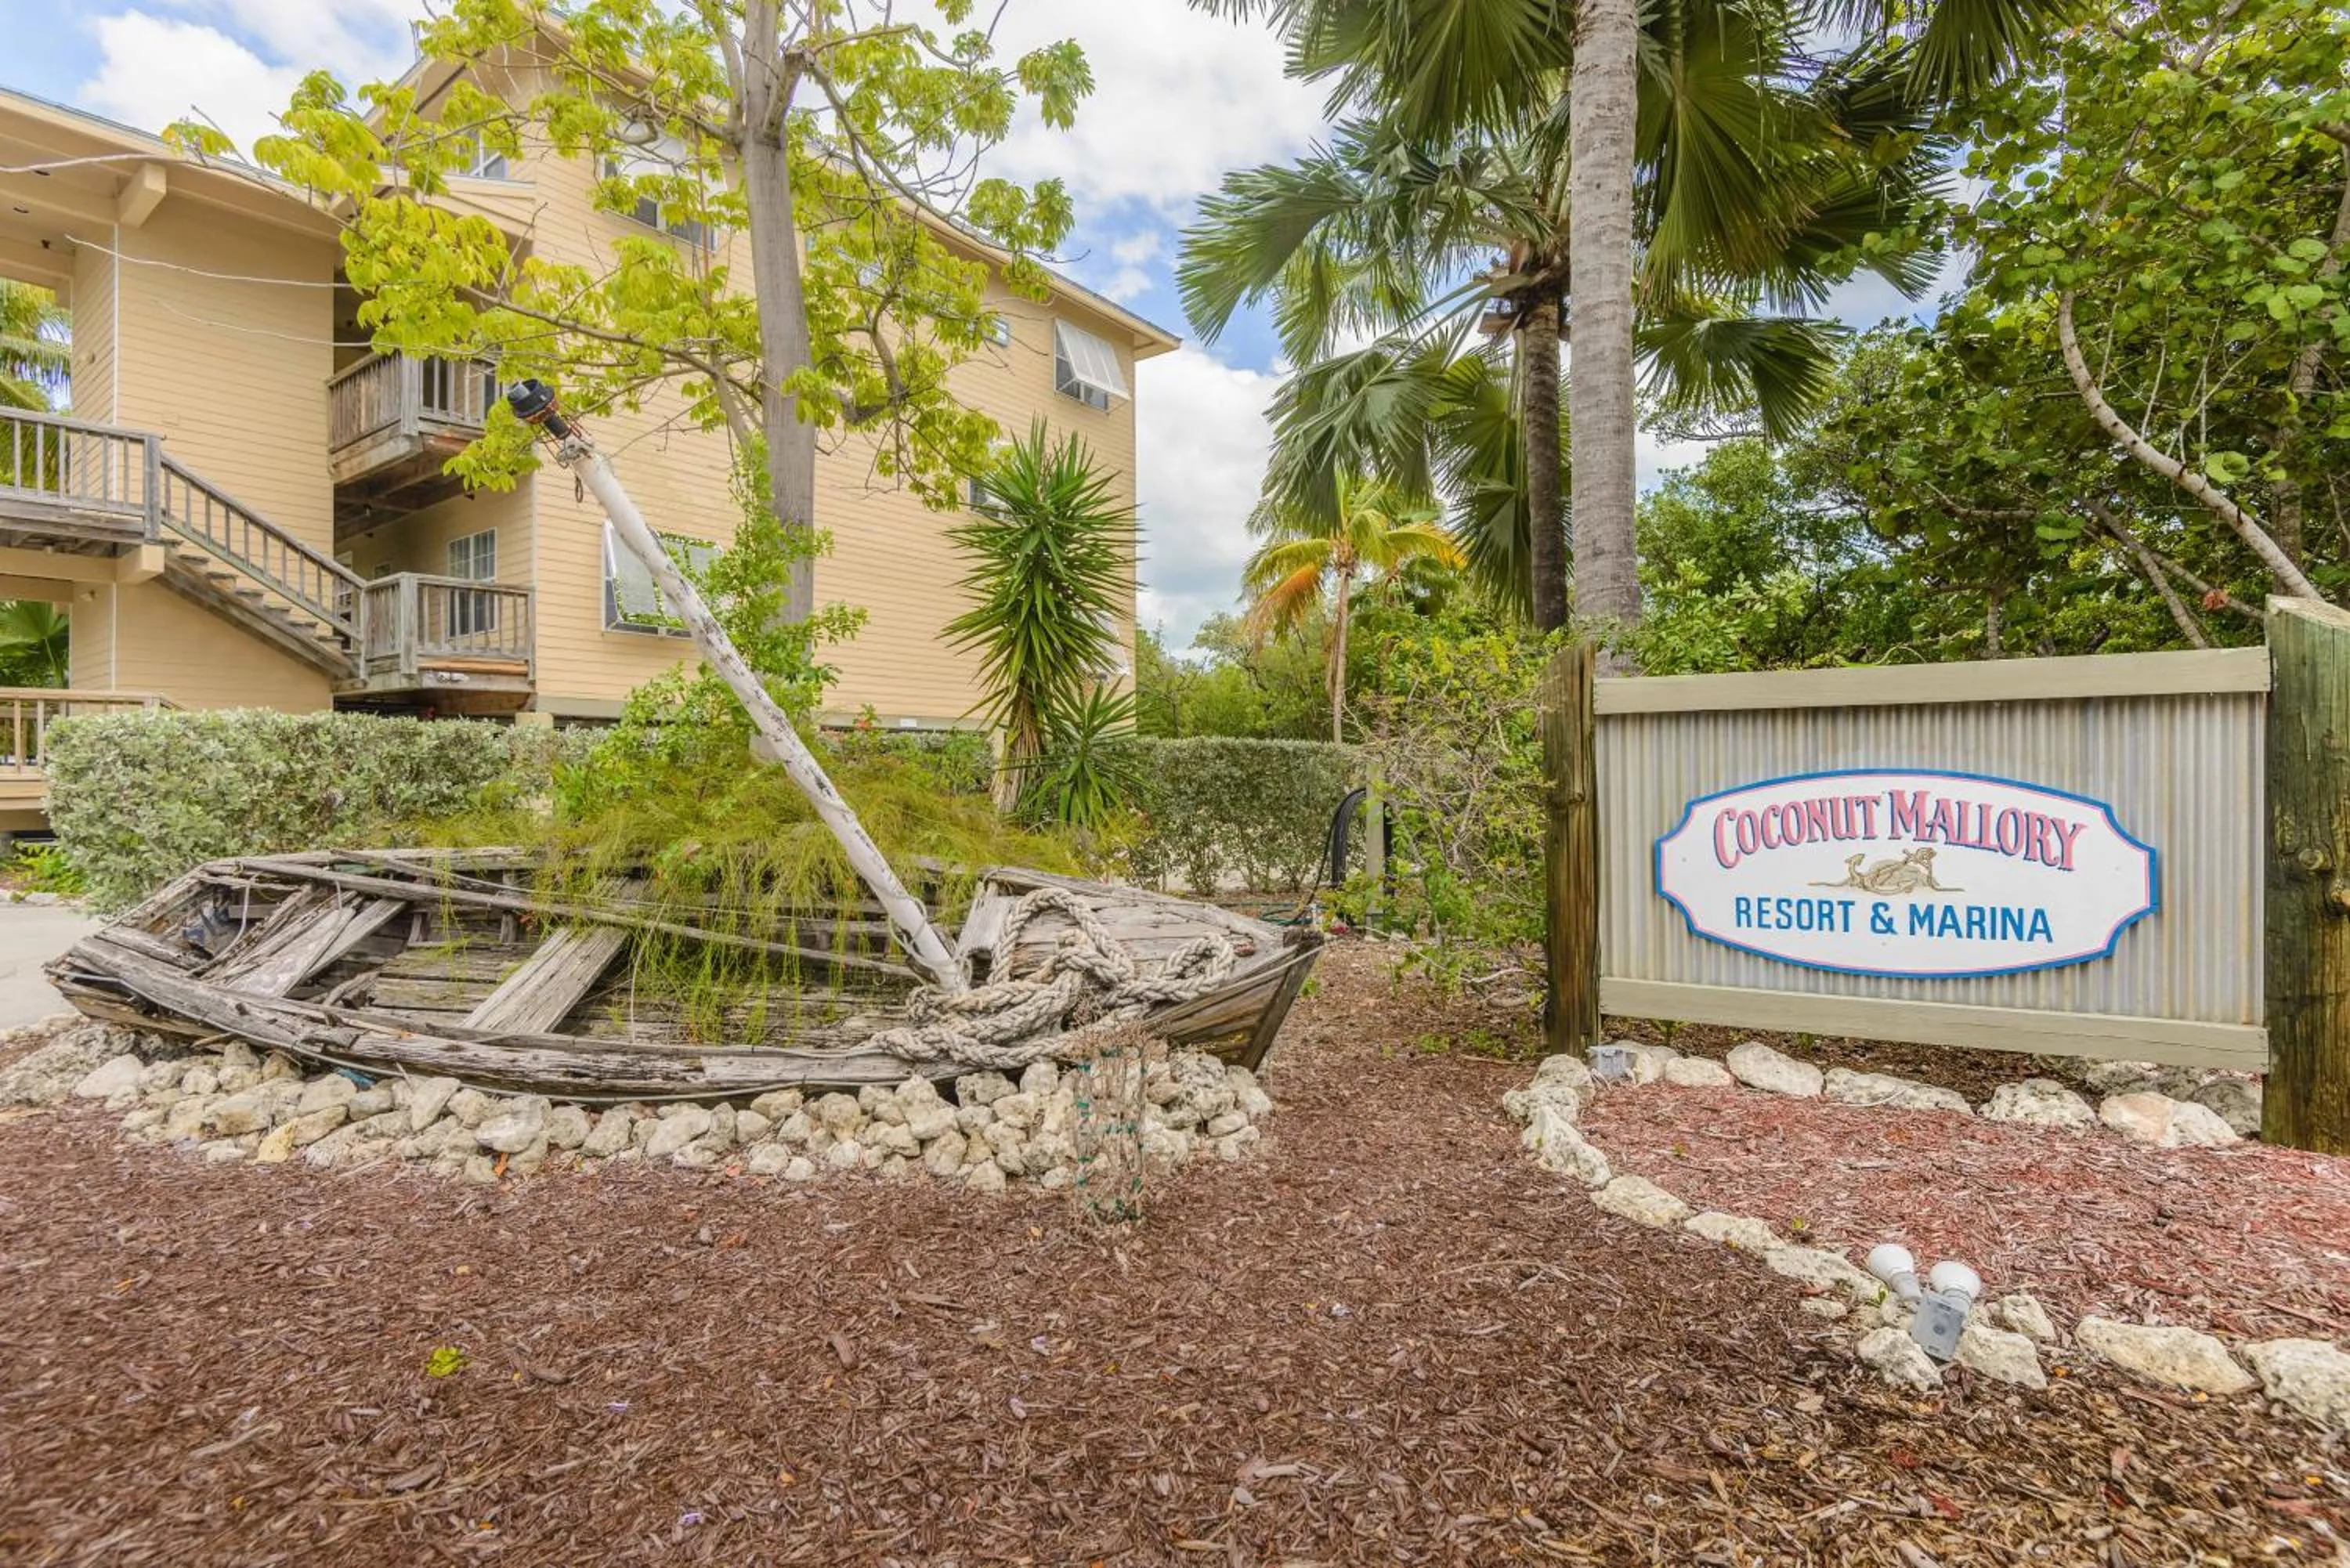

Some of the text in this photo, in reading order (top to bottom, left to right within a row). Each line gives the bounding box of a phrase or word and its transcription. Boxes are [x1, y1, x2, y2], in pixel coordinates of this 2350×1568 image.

[1713, 789, 2088, 872] COCONUT MALLORY
[1734, 896, 2054, 944] RESORT & MARINA
